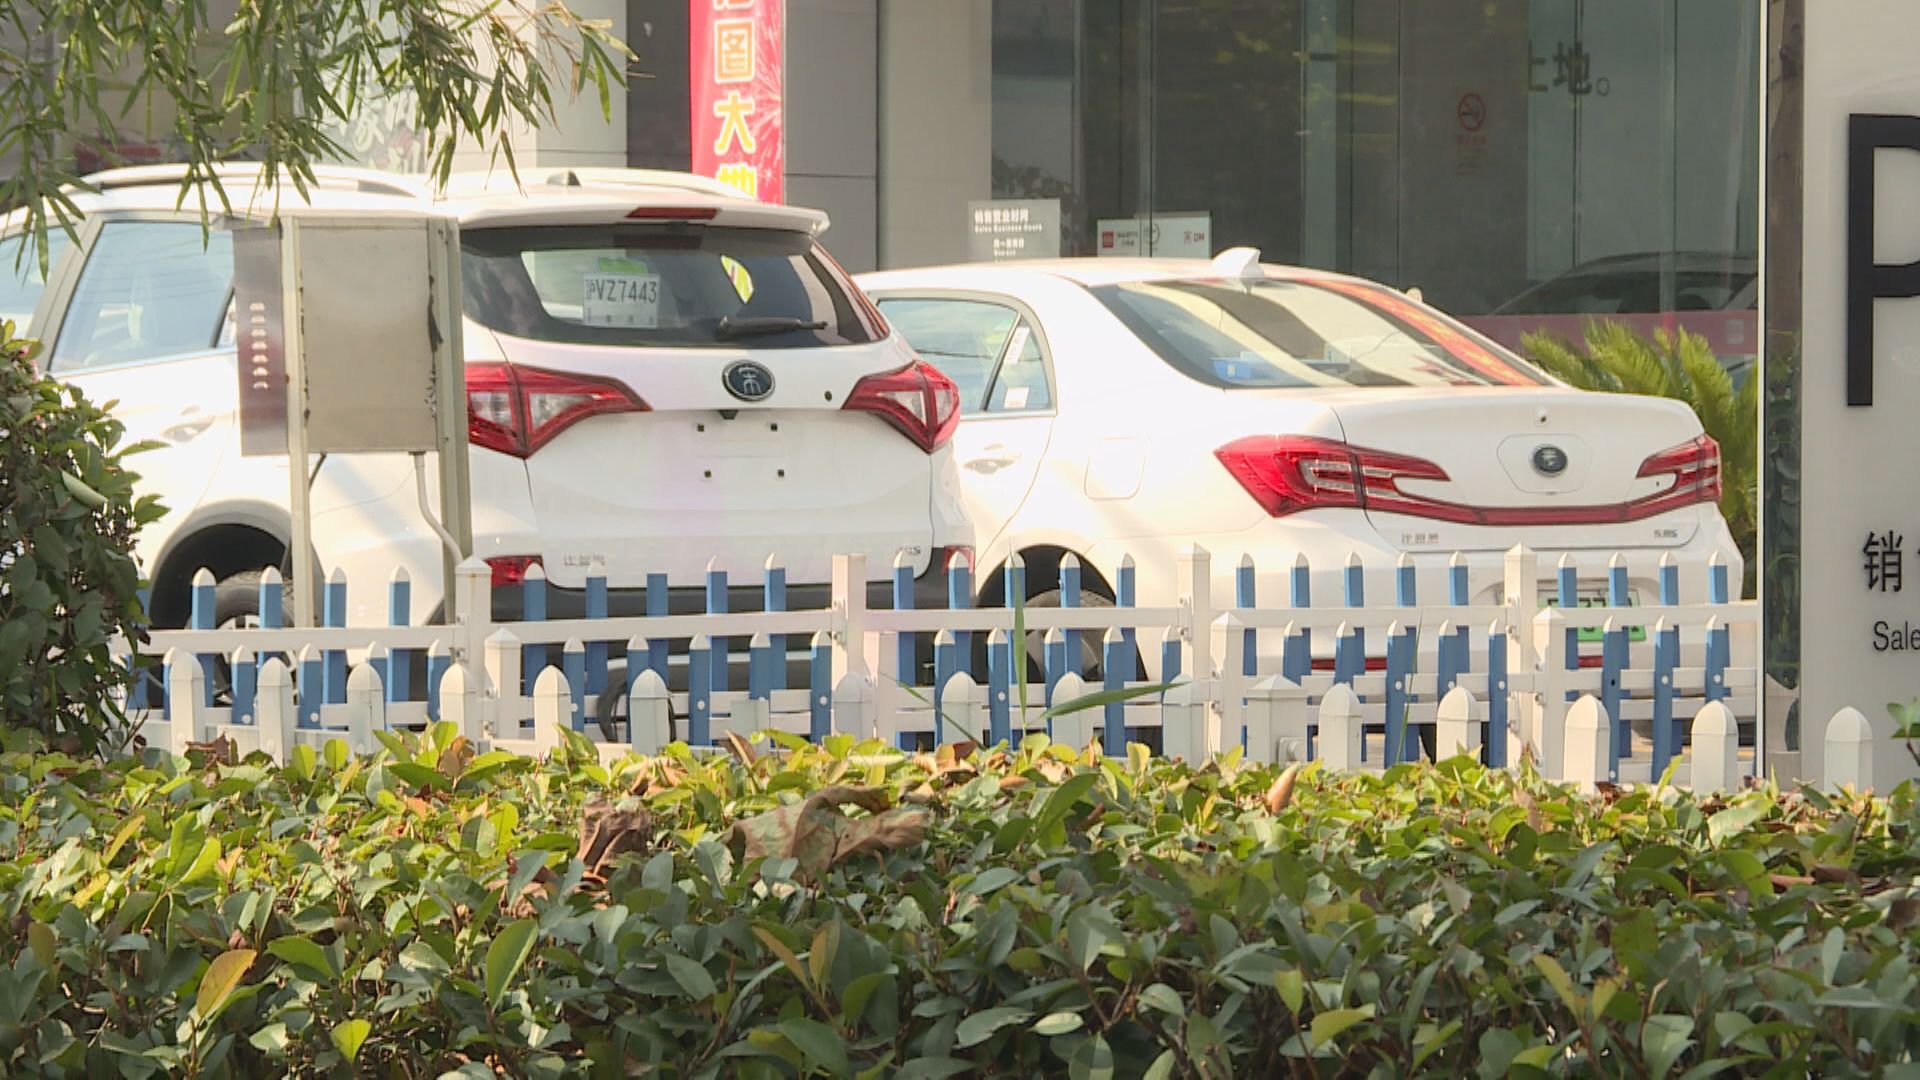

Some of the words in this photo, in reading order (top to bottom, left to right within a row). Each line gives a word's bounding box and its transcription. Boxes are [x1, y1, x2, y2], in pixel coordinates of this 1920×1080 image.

[714, 0, 757, 200] 图大
[1847, 113, 1920, 406] P
[1862, 530, 1920, 592] 销
